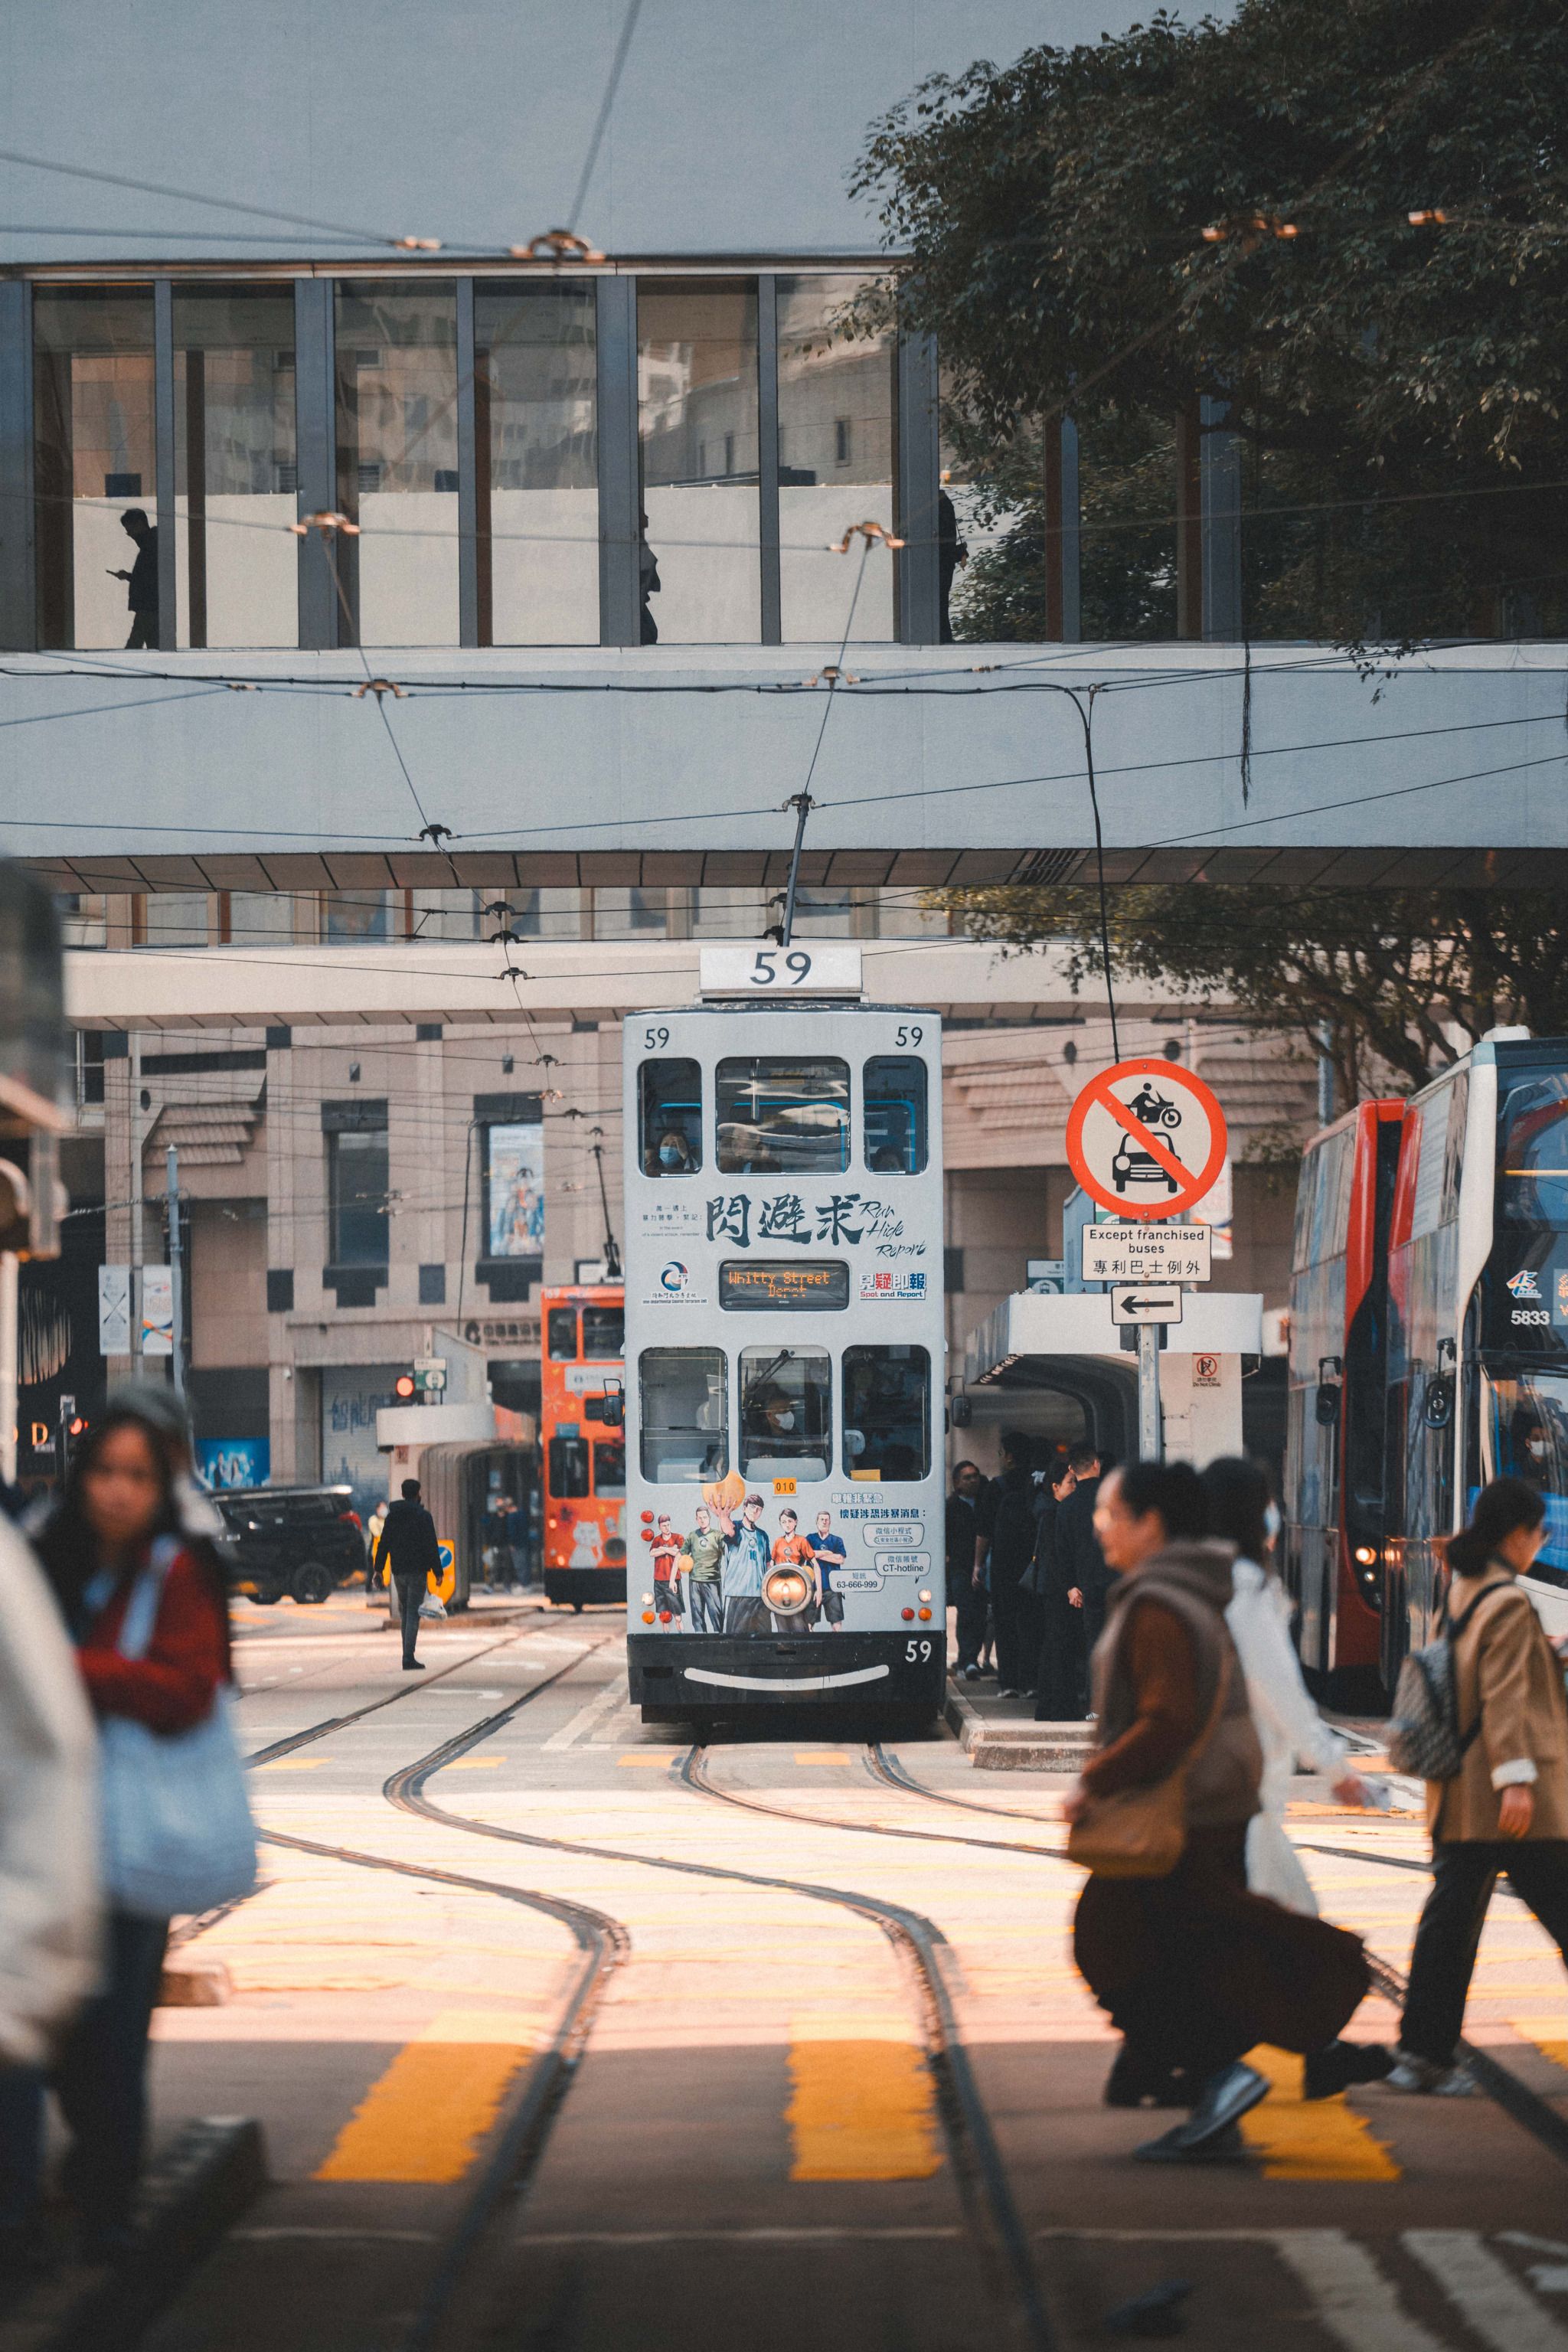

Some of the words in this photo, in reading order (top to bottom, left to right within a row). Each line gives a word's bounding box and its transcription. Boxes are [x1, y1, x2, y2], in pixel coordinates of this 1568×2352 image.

[750, 952, 812, 985] 59
[644, 1027, 670, 1049] 59
[895, 1026, 923, 1047] 59
[858, 1200, 894, 1218] Run
[866, 1220, 903, 1241] Hide
[1089, 1229, 1133, 1242] Except
[1138, 1229, 1204, 1240] franchised
[875, 1240, 926, 1259] Report
[1129, 1243, 1165, 1253] buses
[1093, 1260, 1200, 1275] 專利巴士例外
[729, 1272, 776, 1285] Whitty
[783, 1272, 831, 1285] Street
[858, 1273, 926, 1290] 見疑即報
[1511, 1310, 1550, 1325] 5833
[776, 1482, 794, 1491] 010
[905, 1641, 932, 1662] 59
